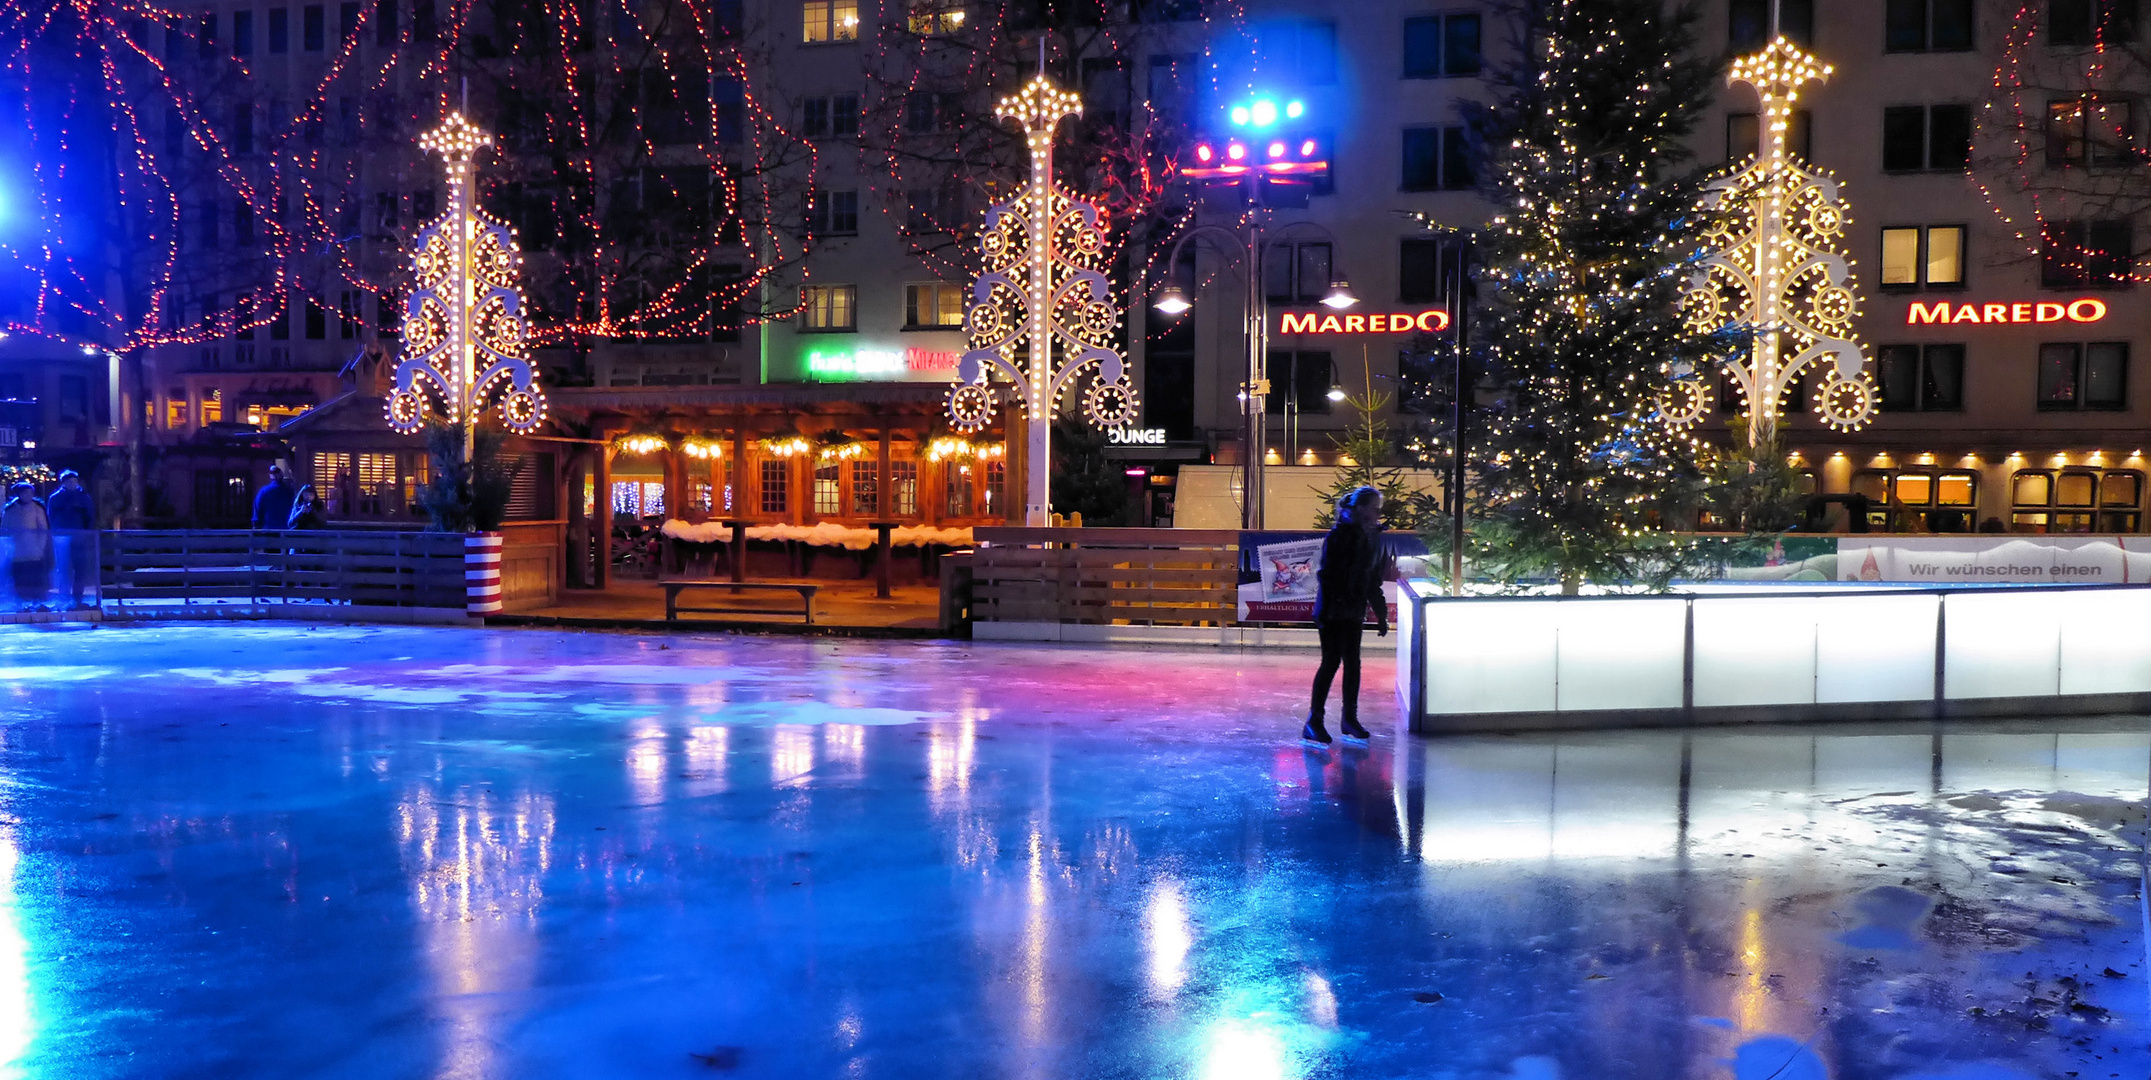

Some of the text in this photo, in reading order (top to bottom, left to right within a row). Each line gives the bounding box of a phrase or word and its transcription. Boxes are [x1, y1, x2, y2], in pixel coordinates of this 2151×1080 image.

[1907, 299, 2107, 324] MAREDO
[1281, 311, 1449, 334] MAREDO
[1107, 428, 1166, 444] OUNGE
[1909, 563, 2102, 576] Wir wünschen einen
